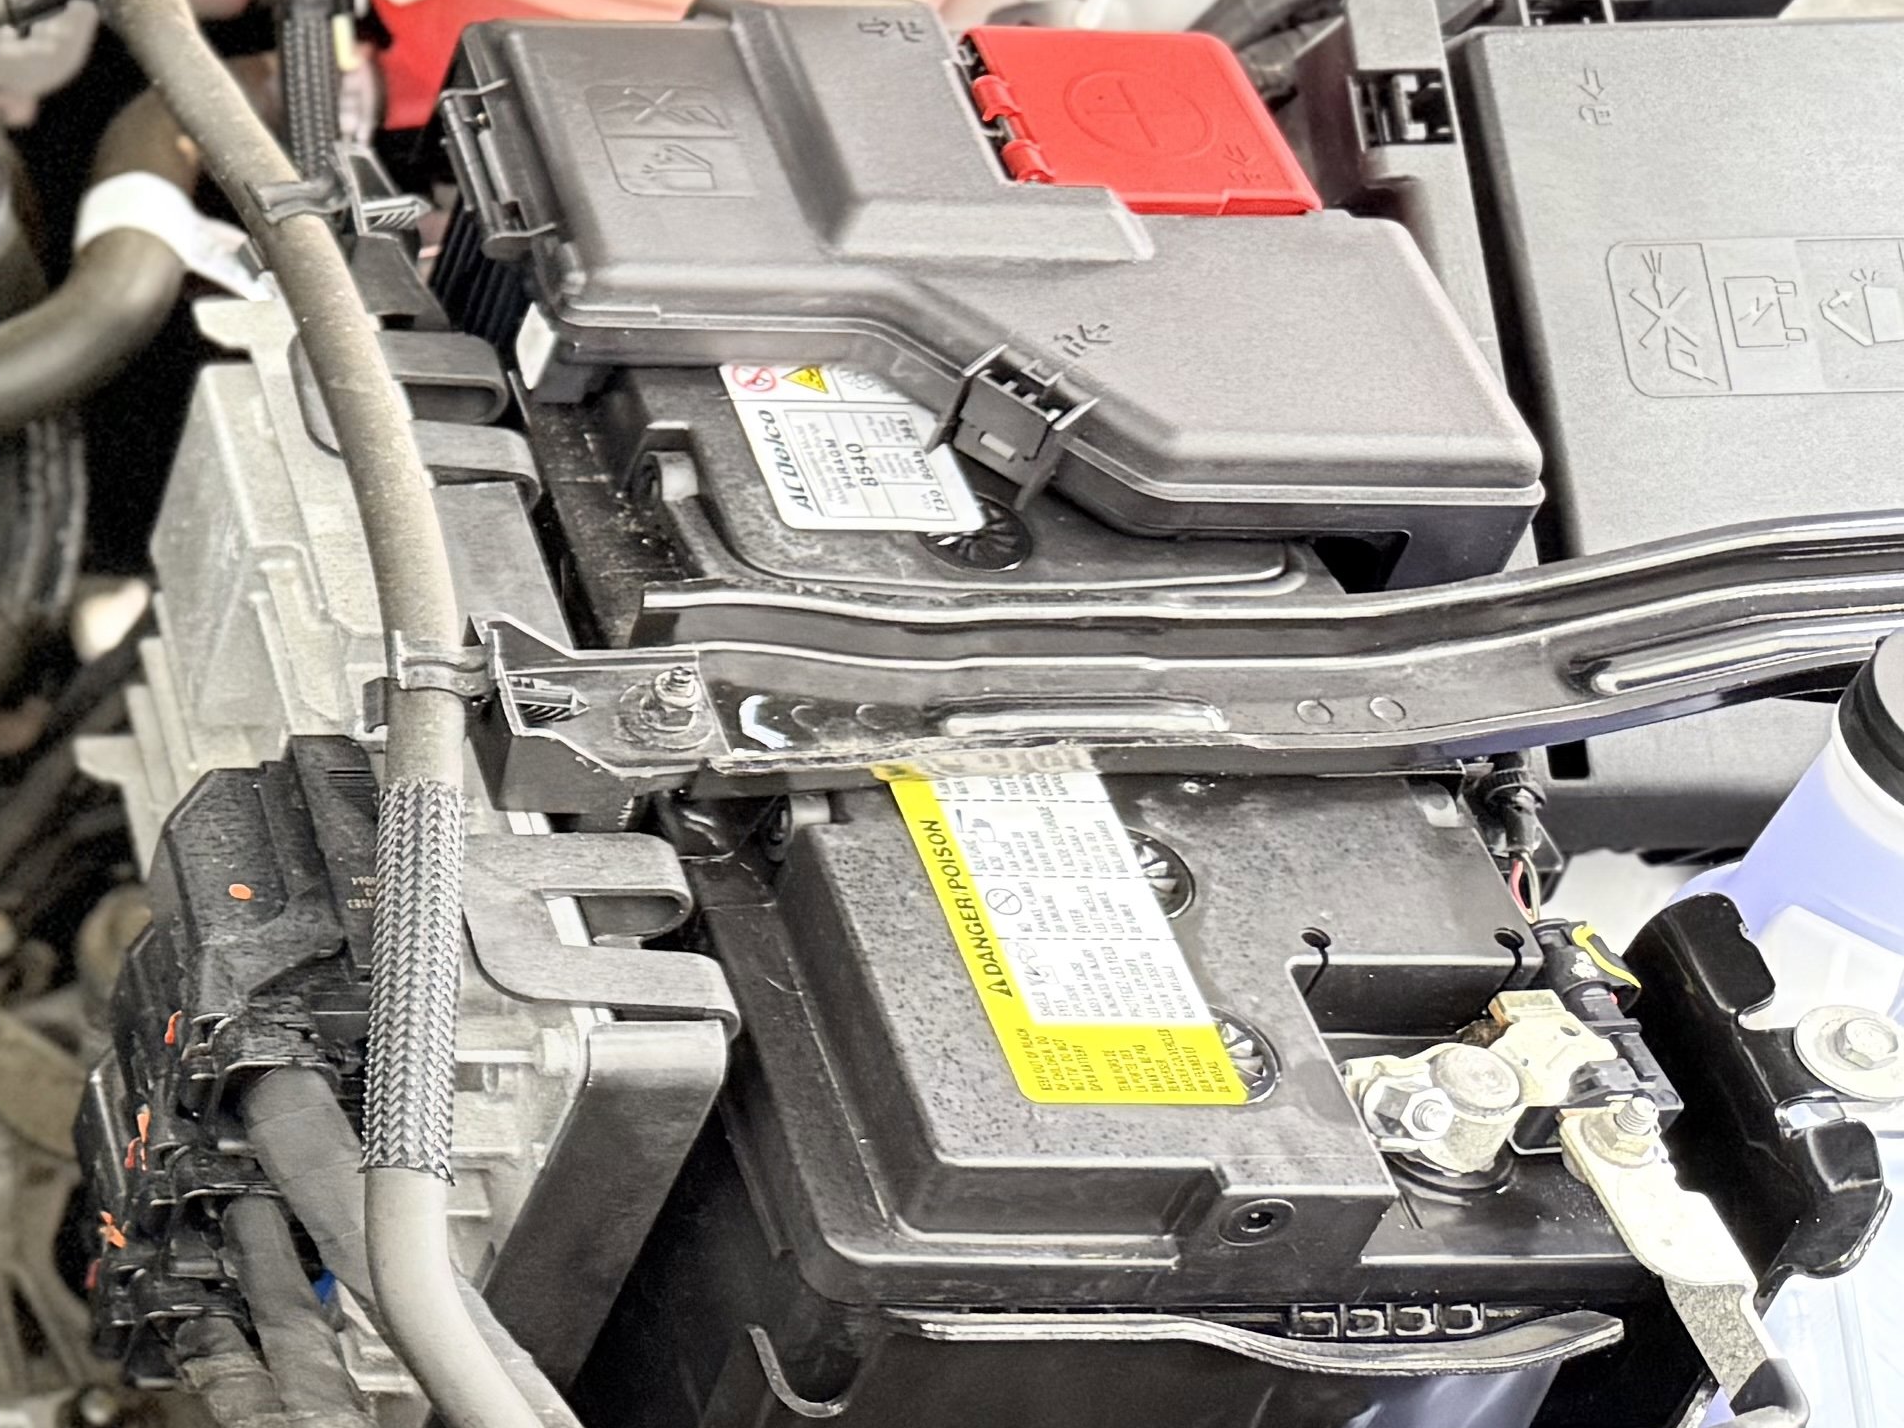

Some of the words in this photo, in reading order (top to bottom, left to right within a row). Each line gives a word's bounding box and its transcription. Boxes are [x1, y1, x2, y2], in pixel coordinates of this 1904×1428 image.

[757, 410, 813, 510] ACDelco
[846, 443, 878, 486] 8540
[919, 819, 1004, 975] DANGER/POISON
